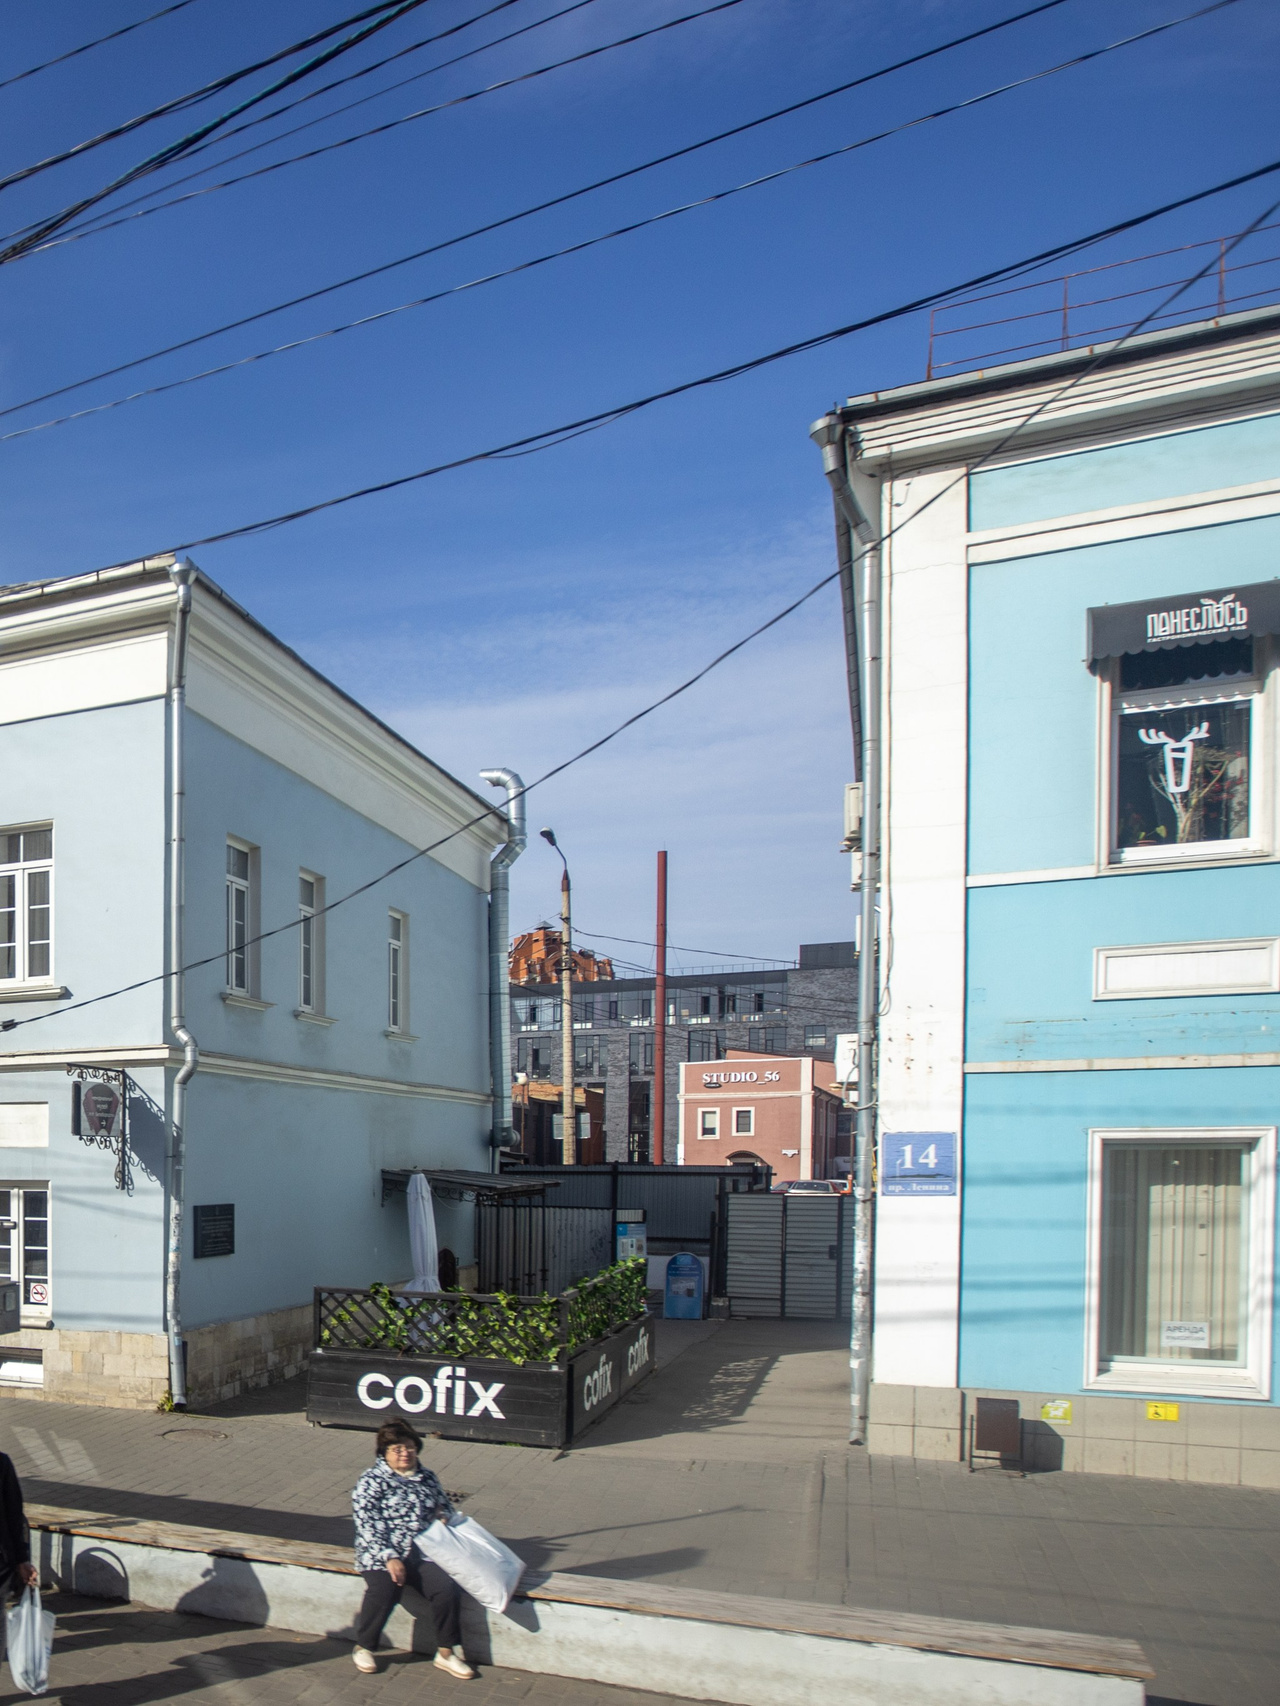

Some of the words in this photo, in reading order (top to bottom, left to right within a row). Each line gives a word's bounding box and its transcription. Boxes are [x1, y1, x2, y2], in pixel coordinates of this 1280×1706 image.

[702, 1070, 780, 1085] STUDIO_56
[900, 1143, 938, 1169] 14
[627, 1326, 650, 1377] cofix
[356, 1365, 506, 1420] cofix
[583, 1353, 613, 1411] cofix
